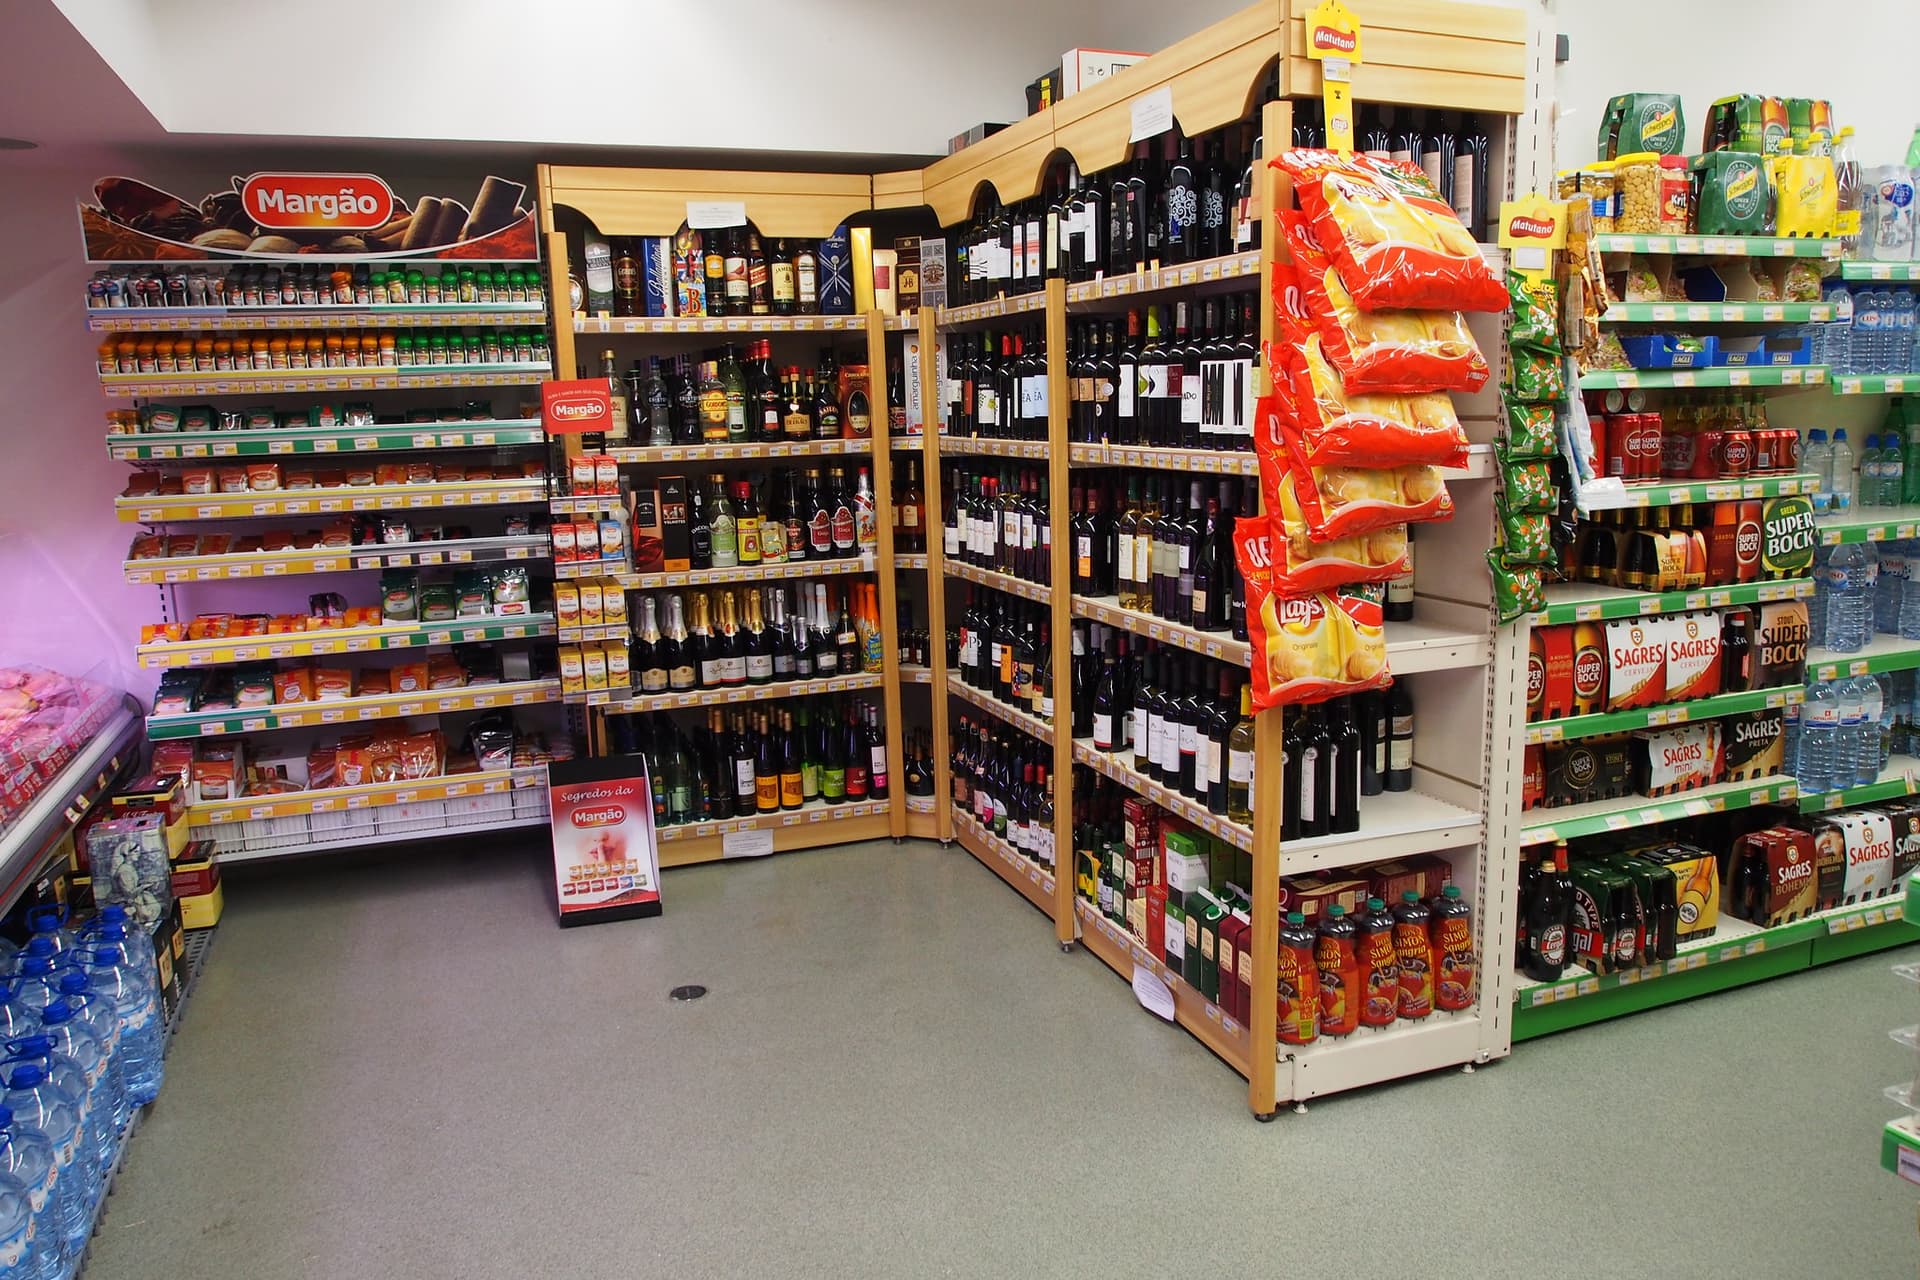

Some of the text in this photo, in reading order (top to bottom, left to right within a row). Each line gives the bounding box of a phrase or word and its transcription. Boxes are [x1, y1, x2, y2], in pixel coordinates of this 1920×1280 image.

[1316, 31, 1355, 48] Matutano
[1766, 144, 1780, 153] BOC
[257, 188, 378, 220] Margão
[1511, 219, 1553, 238] Matutano
[687, 287, 702, 314] B
[912, 355, 921, 410] amarguinha
[555, 402, 603, 417] Margão
[1780, 505, 1796, 515] GREEN
[1766, 512, 1815, 539] SUPER
[1738, 533, 1759, 544] SUPER
[1768, 529, 1815, 557] BOCK
[1738, 542, 1758, 552] BOCK
[1661, 558, 1681, 566] SUPER
[1662, 564, 1681, 572] BOCK
[1776, 615, 1794, 625] STOUT
[1761, 624, 1808, 645] SUPER
[1614, 643, 1665, 669] SAGRES
[1670, 636, 1718, 663] SAGRES
[1762, 642, 1806, 665] BOCK
[1528, 669, 1542, 682] PER
[1577, 661, 1601, 675] SUPER
[1577, 671, 1599, 684] BOCK
[1736, 715, 1782, 743] SAGRES
[1748, 737, 1769, 748] PRETA
[1663, 743, 1702, 765] SAGRES
[1571, 756, 1591, 769] SUPER
[1572, 763, 1592, 775] BOCK
[1674, 761, 1694, 774] mini
[561, 785, 634, 804] Segredos da
[575, 809, 623, 823] Margão
[1849, 841, 1890, 867] SAGRES
[1895, 836, 1920, 857] SAG
[1778, 860, 1812, 882] SAGRES
[1583, 895, 1599, 930] TYPE
[1399, 928, 1418, 937] DON
[1449, 923, 1466, 932] DON
[1443, 931, 1470, 944] SIMON
[1572, 932, 1593, 953] gal
[1396, 945, 1427, 957] angria
[1370, 953, 1396, 968] Sangri
